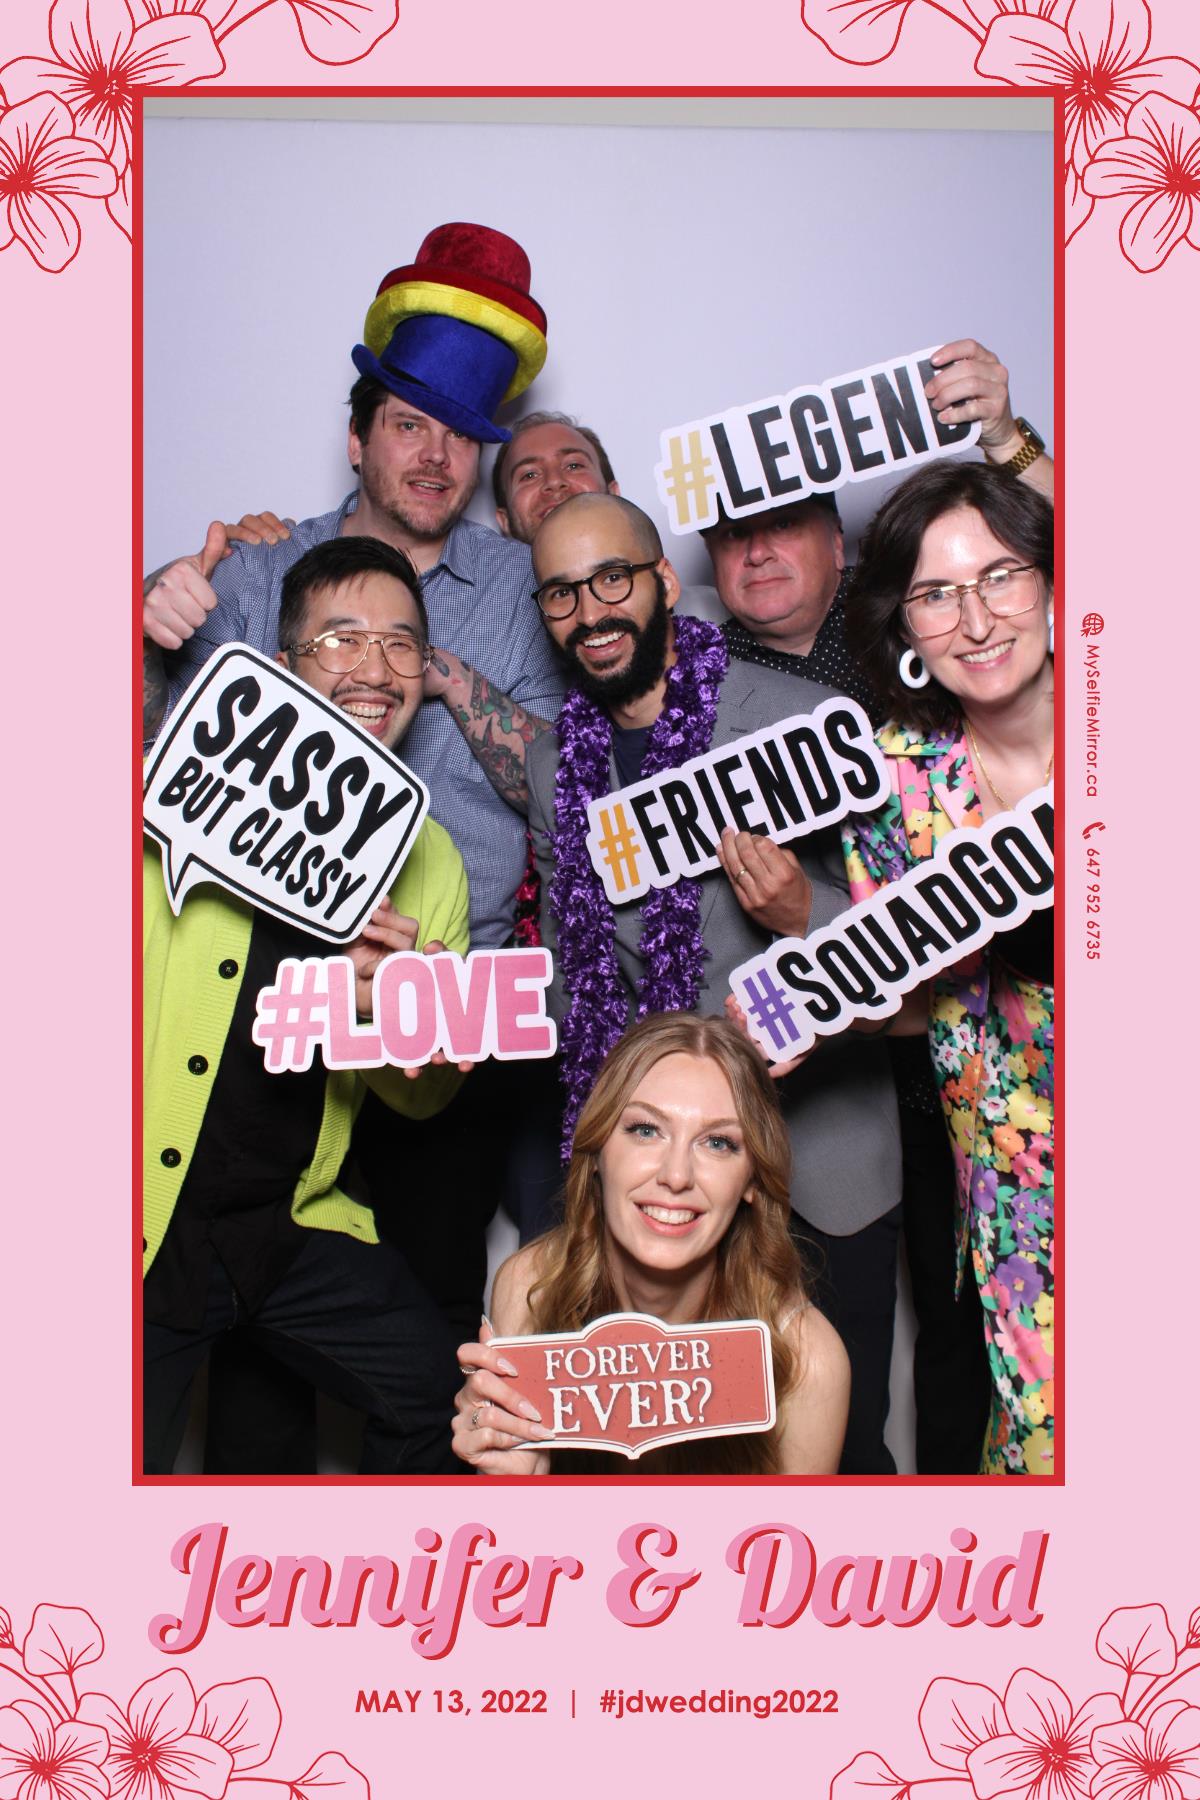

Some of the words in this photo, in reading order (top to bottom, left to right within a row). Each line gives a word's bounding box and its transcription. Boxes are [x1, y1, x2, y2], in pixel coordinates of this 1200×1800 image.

[193, 675, 412, 860] SASSY
[598, 709, 881, 892] #FRIENDS
[158, 756, 245, 836] BUT
[229, 807, 366, 920] CLASSY
[258, 953, 551, 1067] #LOVE
[544, 1339, 712, 1381] FOREVER
[548, 1377, 712, 1434] EVER?
